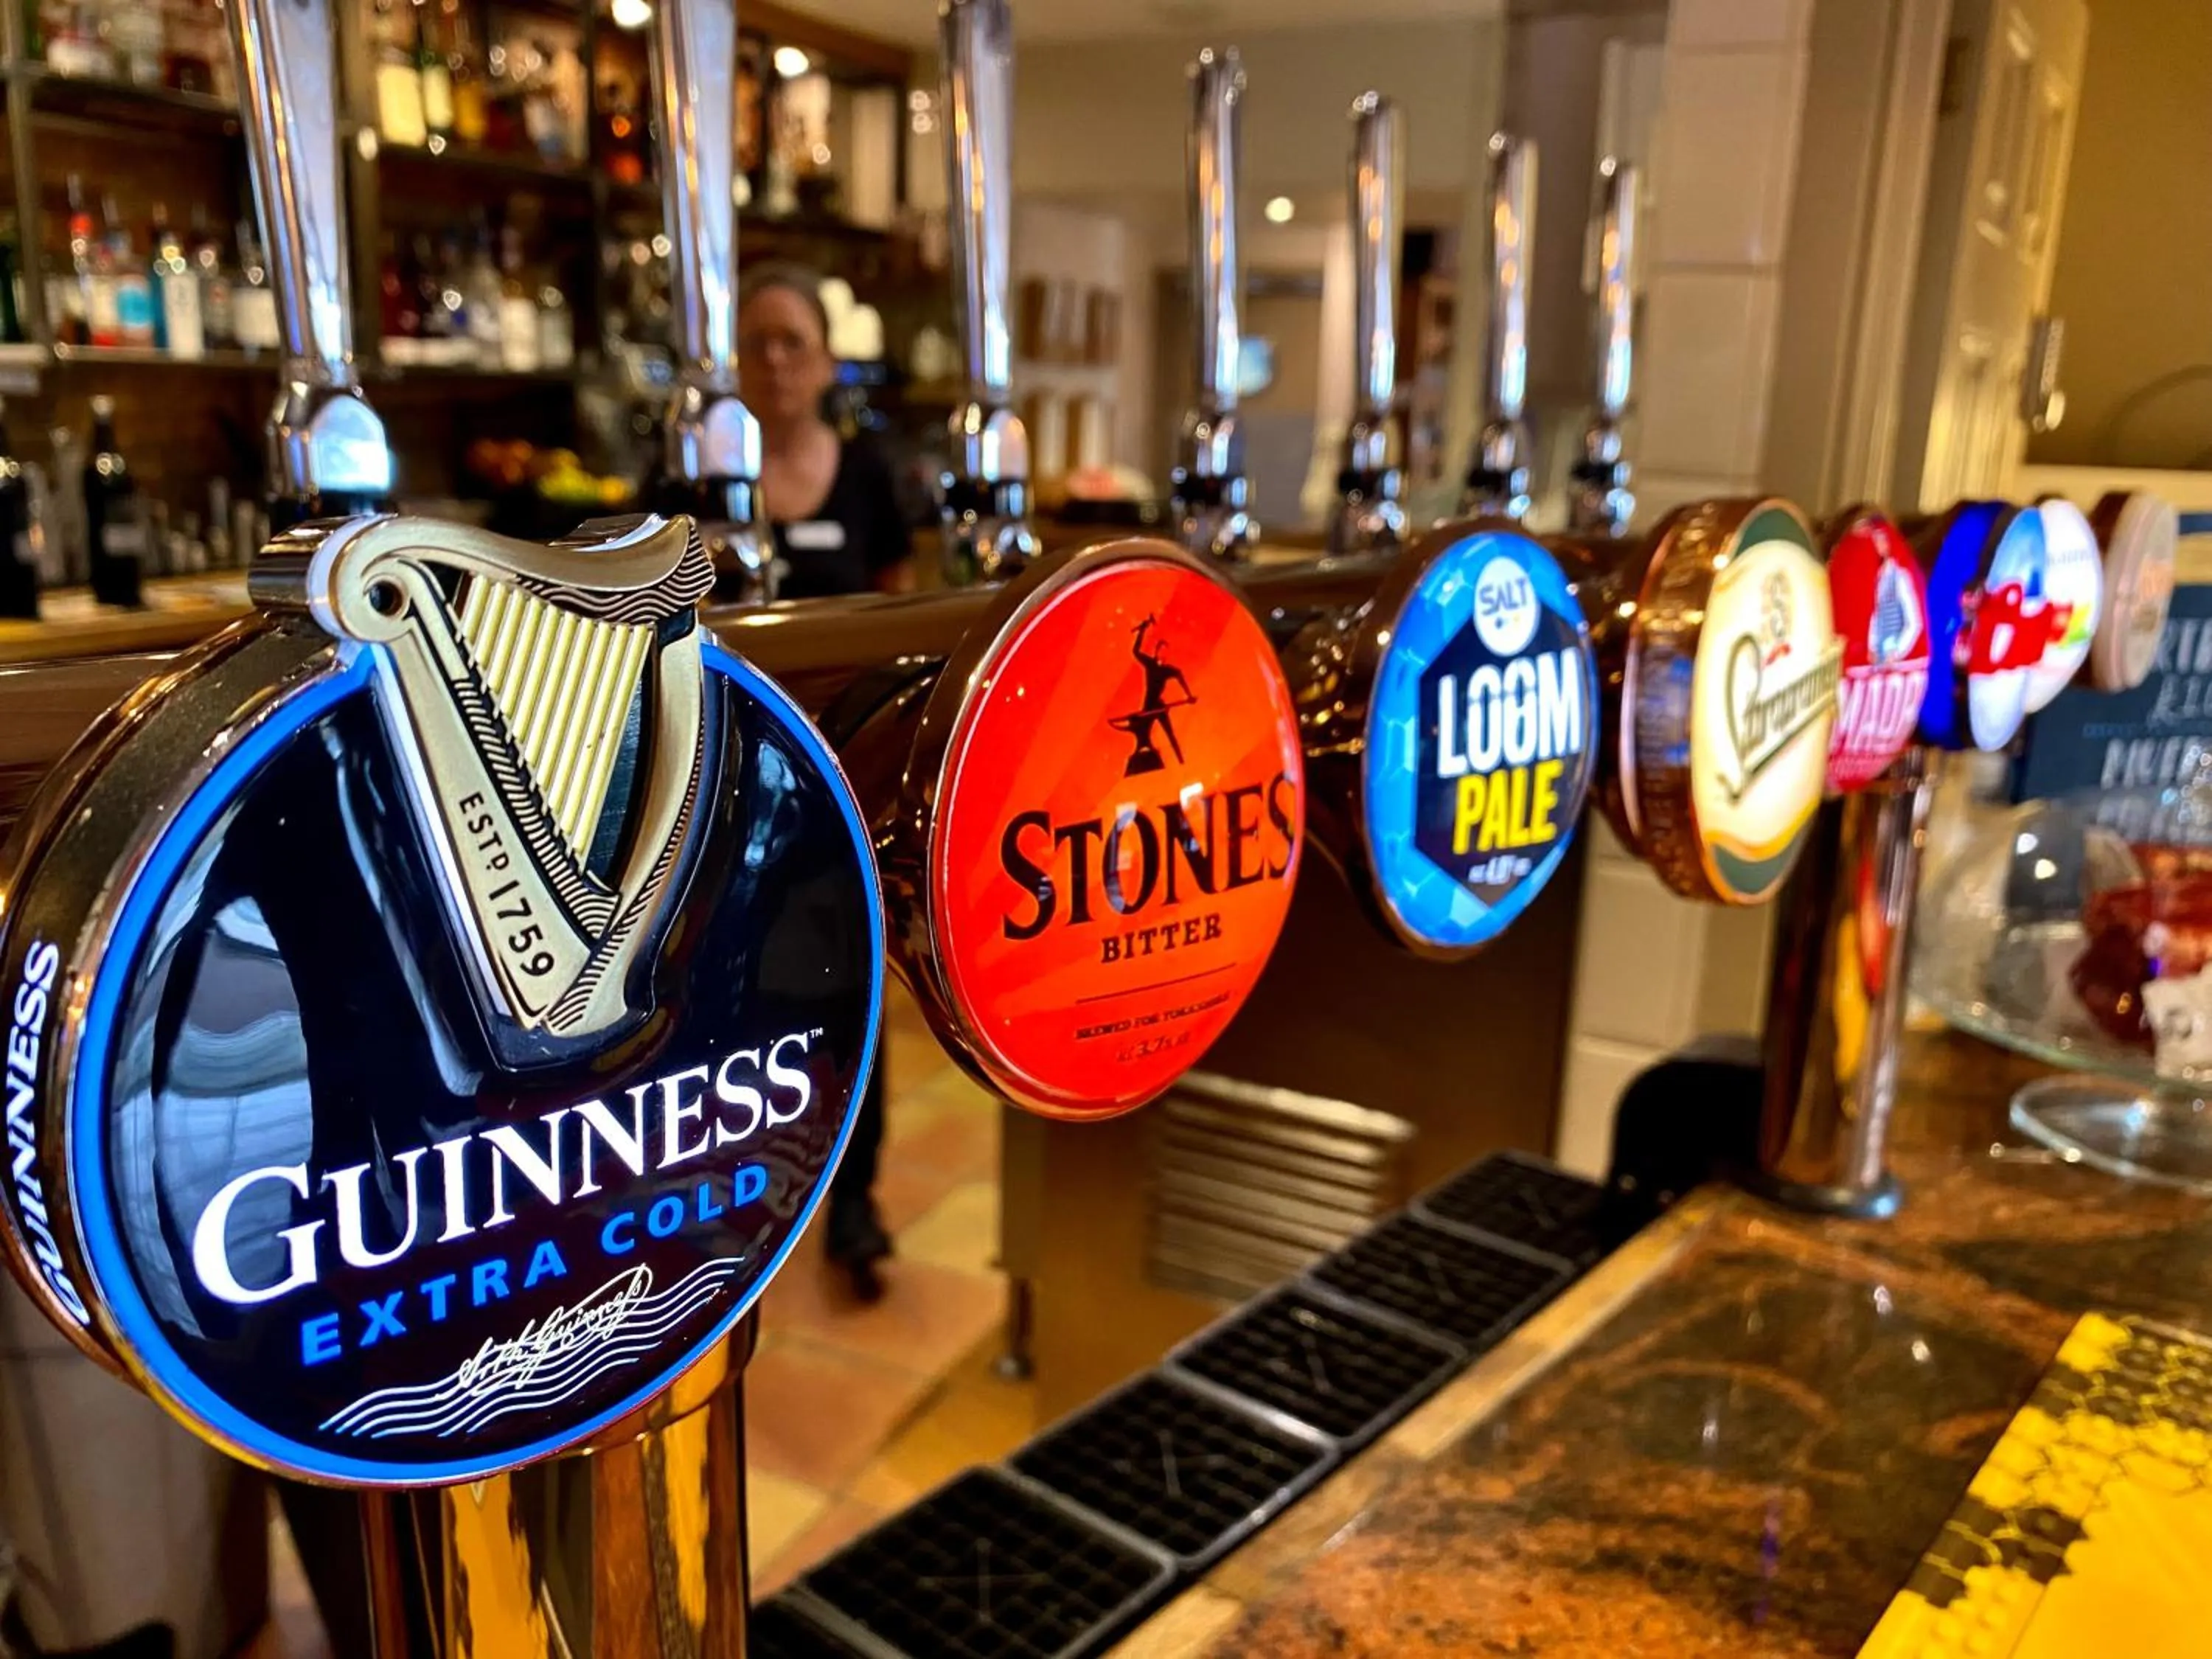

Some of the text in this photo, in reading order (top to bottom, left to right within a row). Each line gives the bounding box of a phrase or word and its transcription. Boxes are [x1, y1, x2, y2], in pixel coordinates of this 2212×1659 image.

[1478, 577, 1528, 616] SALT
[1438, 647, 1582, 779] LOOM
[1000, 771, 1298, 941] STONES
[1453, 759, 1564, 855] PALE
[488, 880, 555, 977] 1759
[1101, 913, 1222, 964] BITTER
[6, 939, 91, 1325] GUINNESS
[192, 1033, 810, 1305] GUINNESS
[302, 1164, 770, 1366] EXTRA COLD
